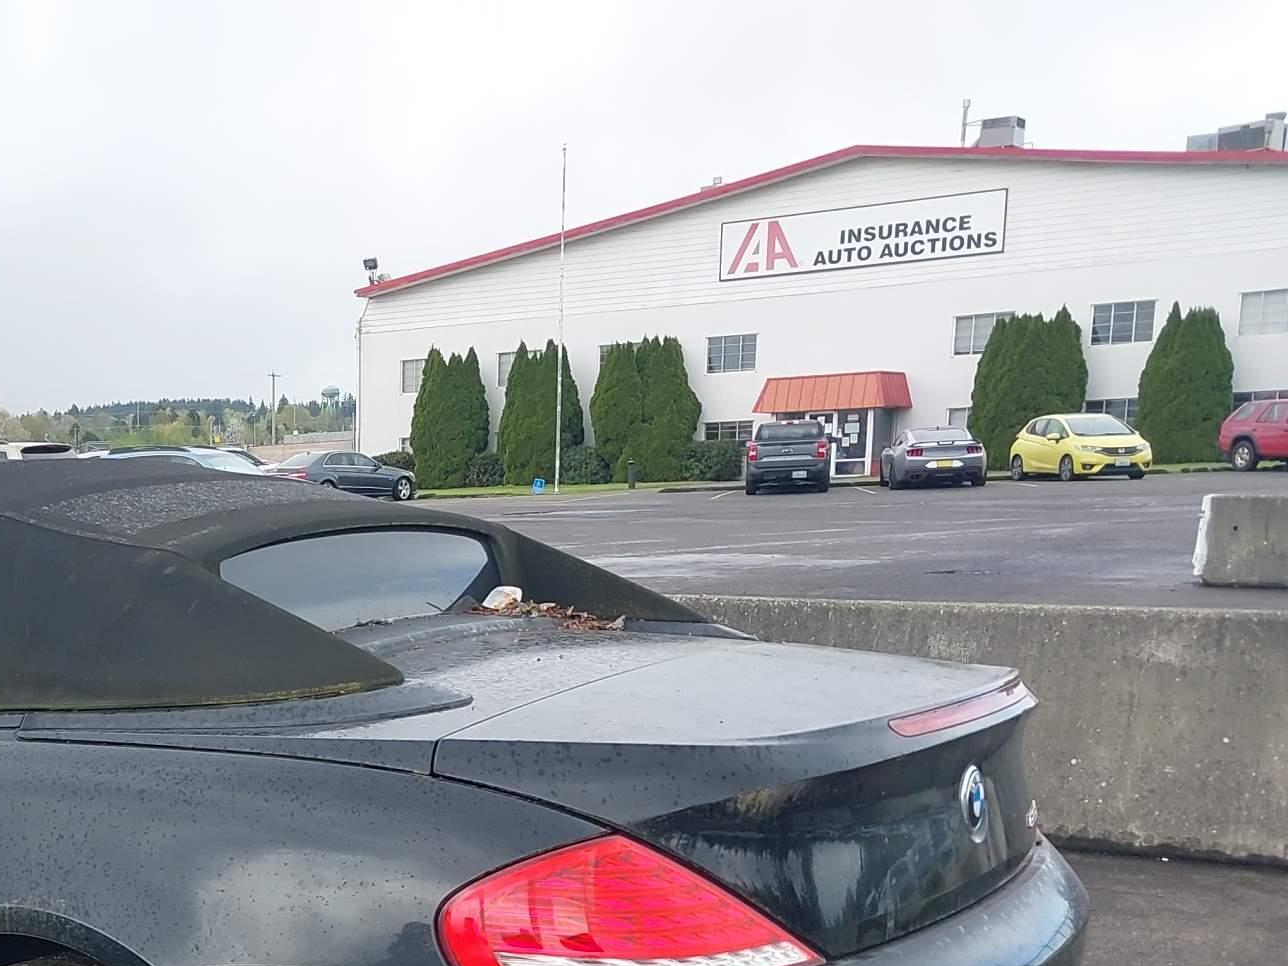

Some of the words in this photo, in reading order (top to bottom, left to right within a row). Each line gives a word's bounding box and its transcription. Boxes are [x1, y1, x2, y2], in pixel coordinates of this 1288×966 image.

[839, 215, 973, 245] INSURANCE
[813, 245, 873, 267] AUTO
[879, 231, 999, 260] AUCTIONS
